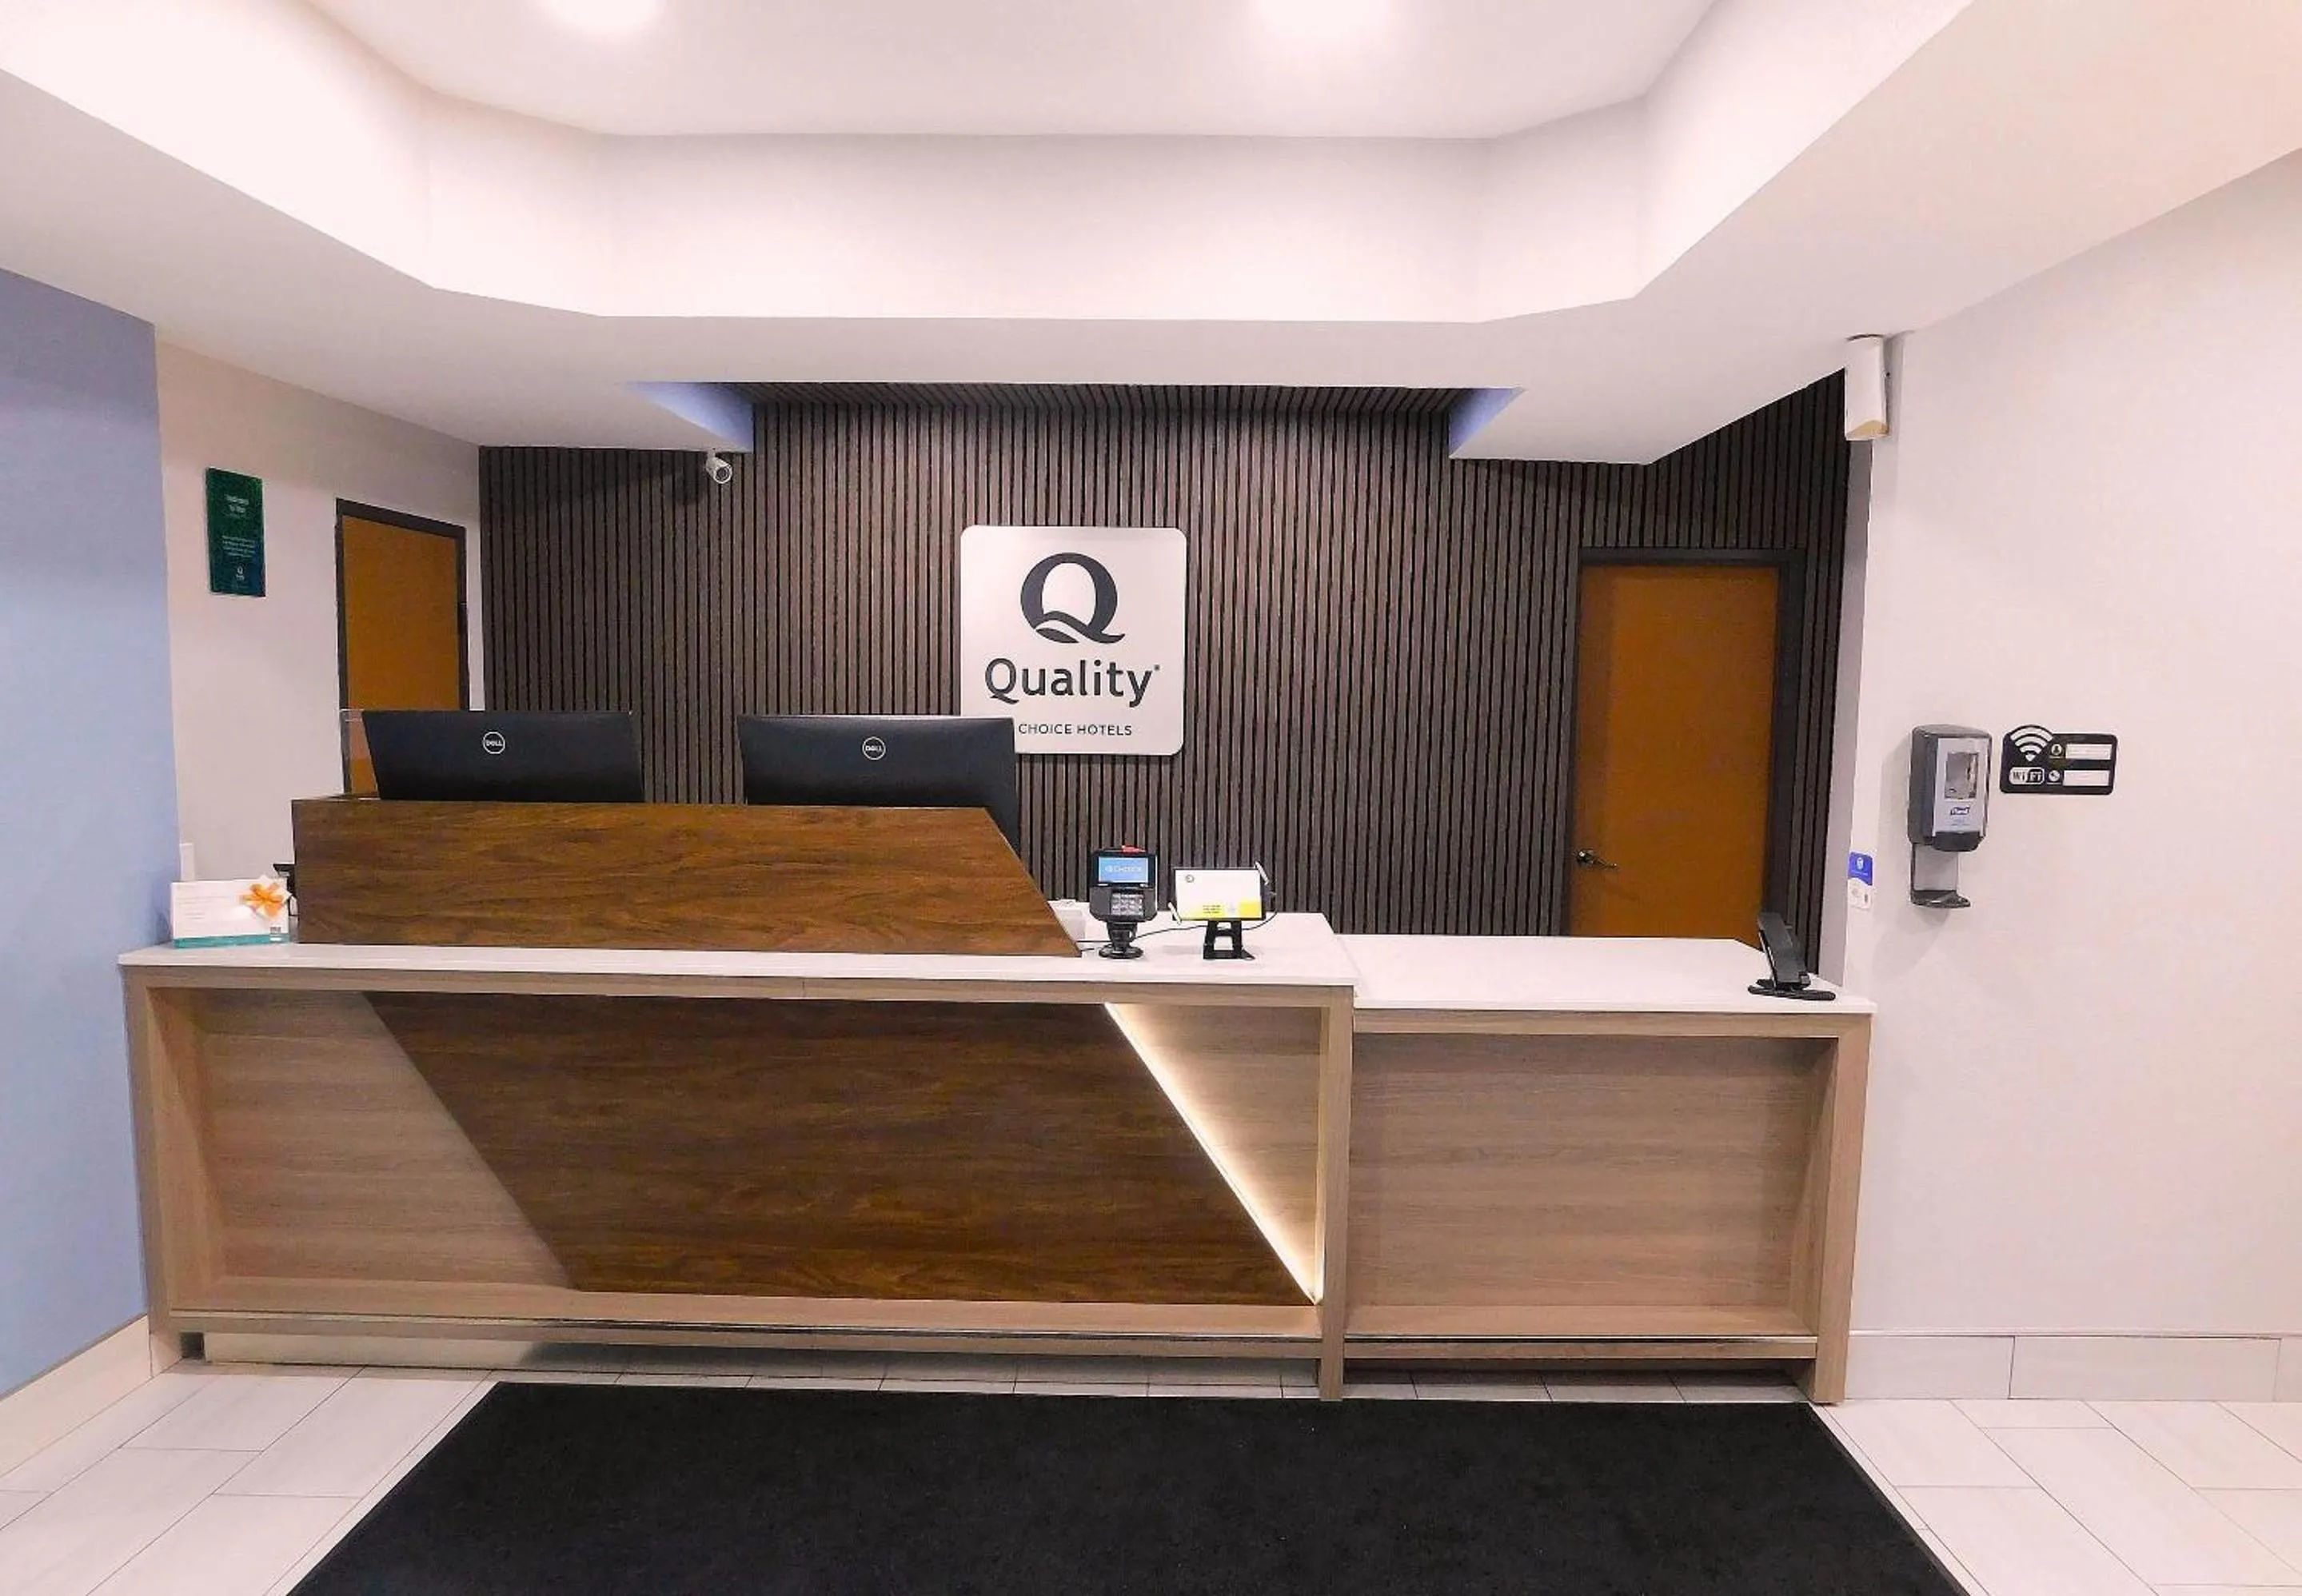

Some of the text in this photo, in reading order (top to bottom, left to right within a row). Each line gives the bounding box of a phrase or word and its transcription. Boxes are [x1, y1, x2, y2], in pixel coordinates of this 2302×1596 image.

[984, 657, 1153, 708] Quality
[1018, 723, 1132, 736] CHOICE HOTELS
